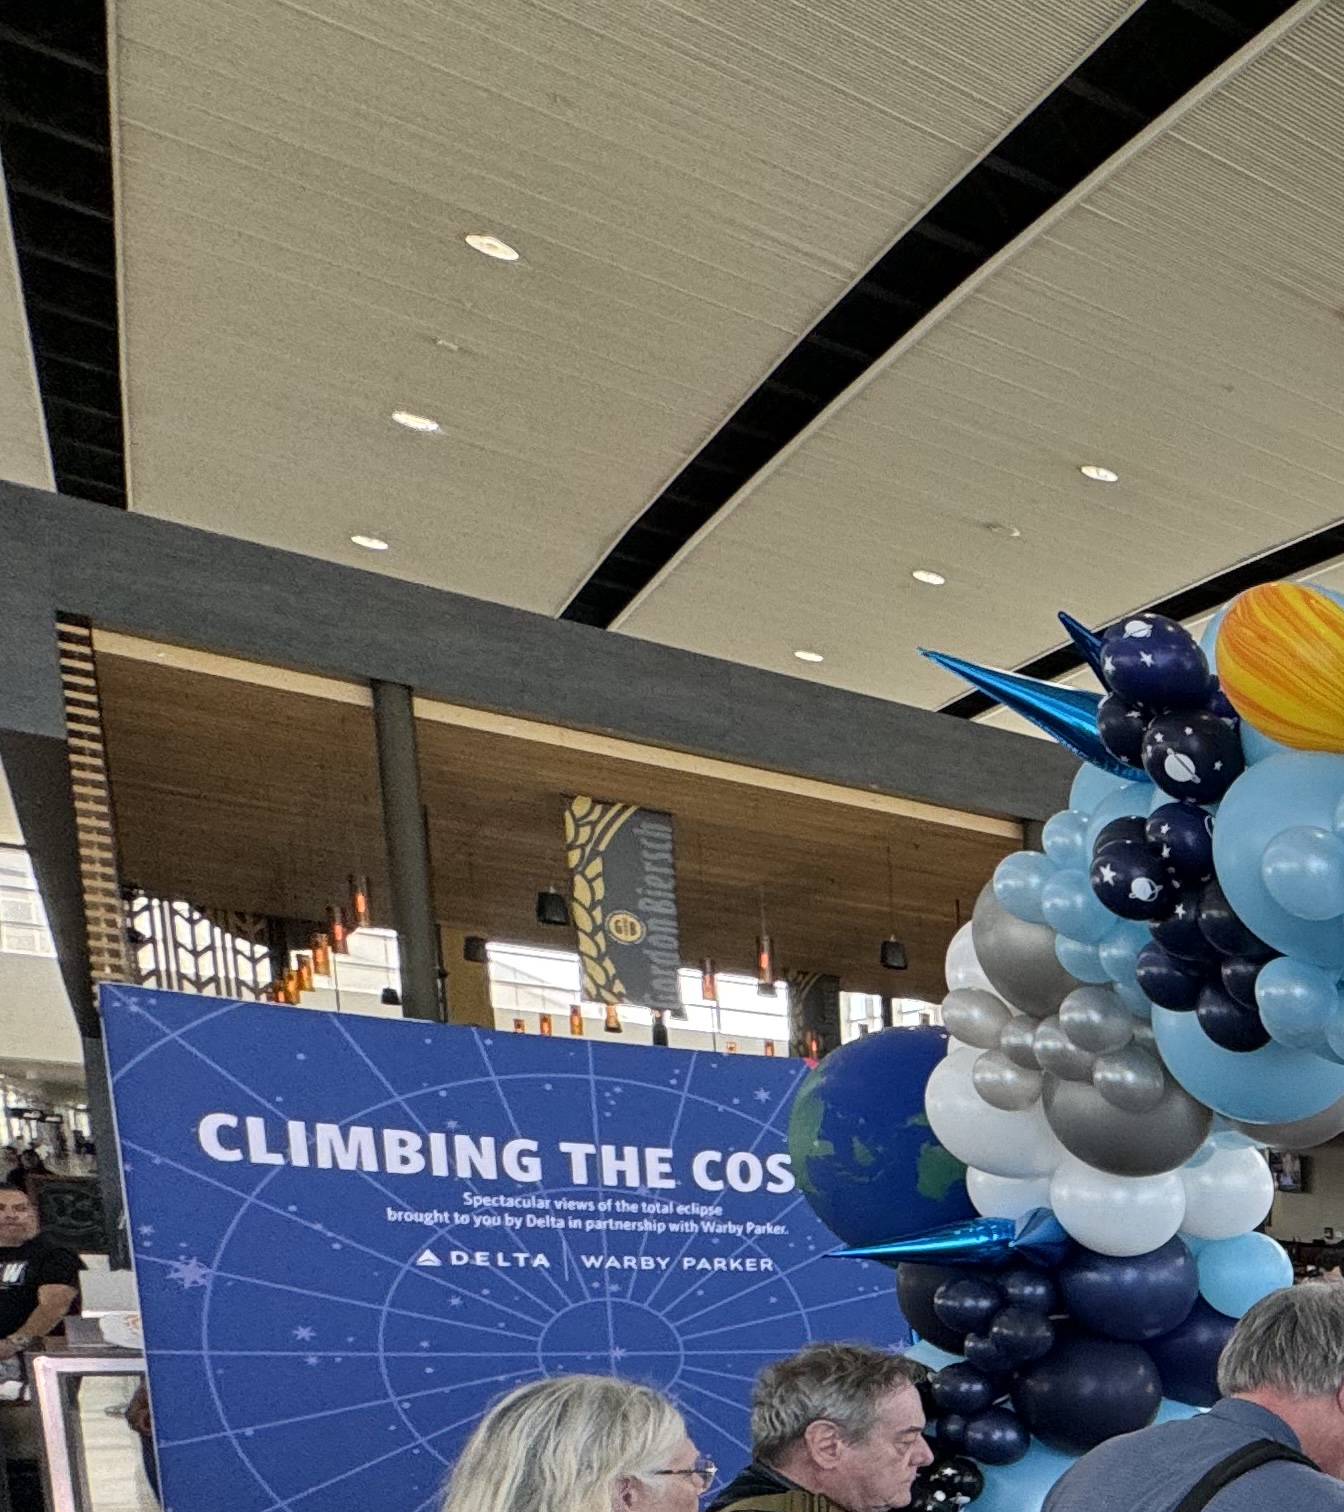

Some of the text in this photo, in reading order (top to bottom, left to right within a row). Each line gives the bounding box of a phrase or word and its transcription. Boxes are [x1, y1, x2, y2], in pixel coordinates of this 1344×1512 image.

[632, 821, 681, 1010] Gordon Biersch
[199, 1112, 796, 1194] CLIMBING THE COS
[463, 1191, 723, 1217] Spectacular views of the total eclipse
[386, 1206, 789, 1236] brought to you by Delta in partnership with Warby Parker.
[450, 1251, 774, 1272] DELTA WARBY PARKER
